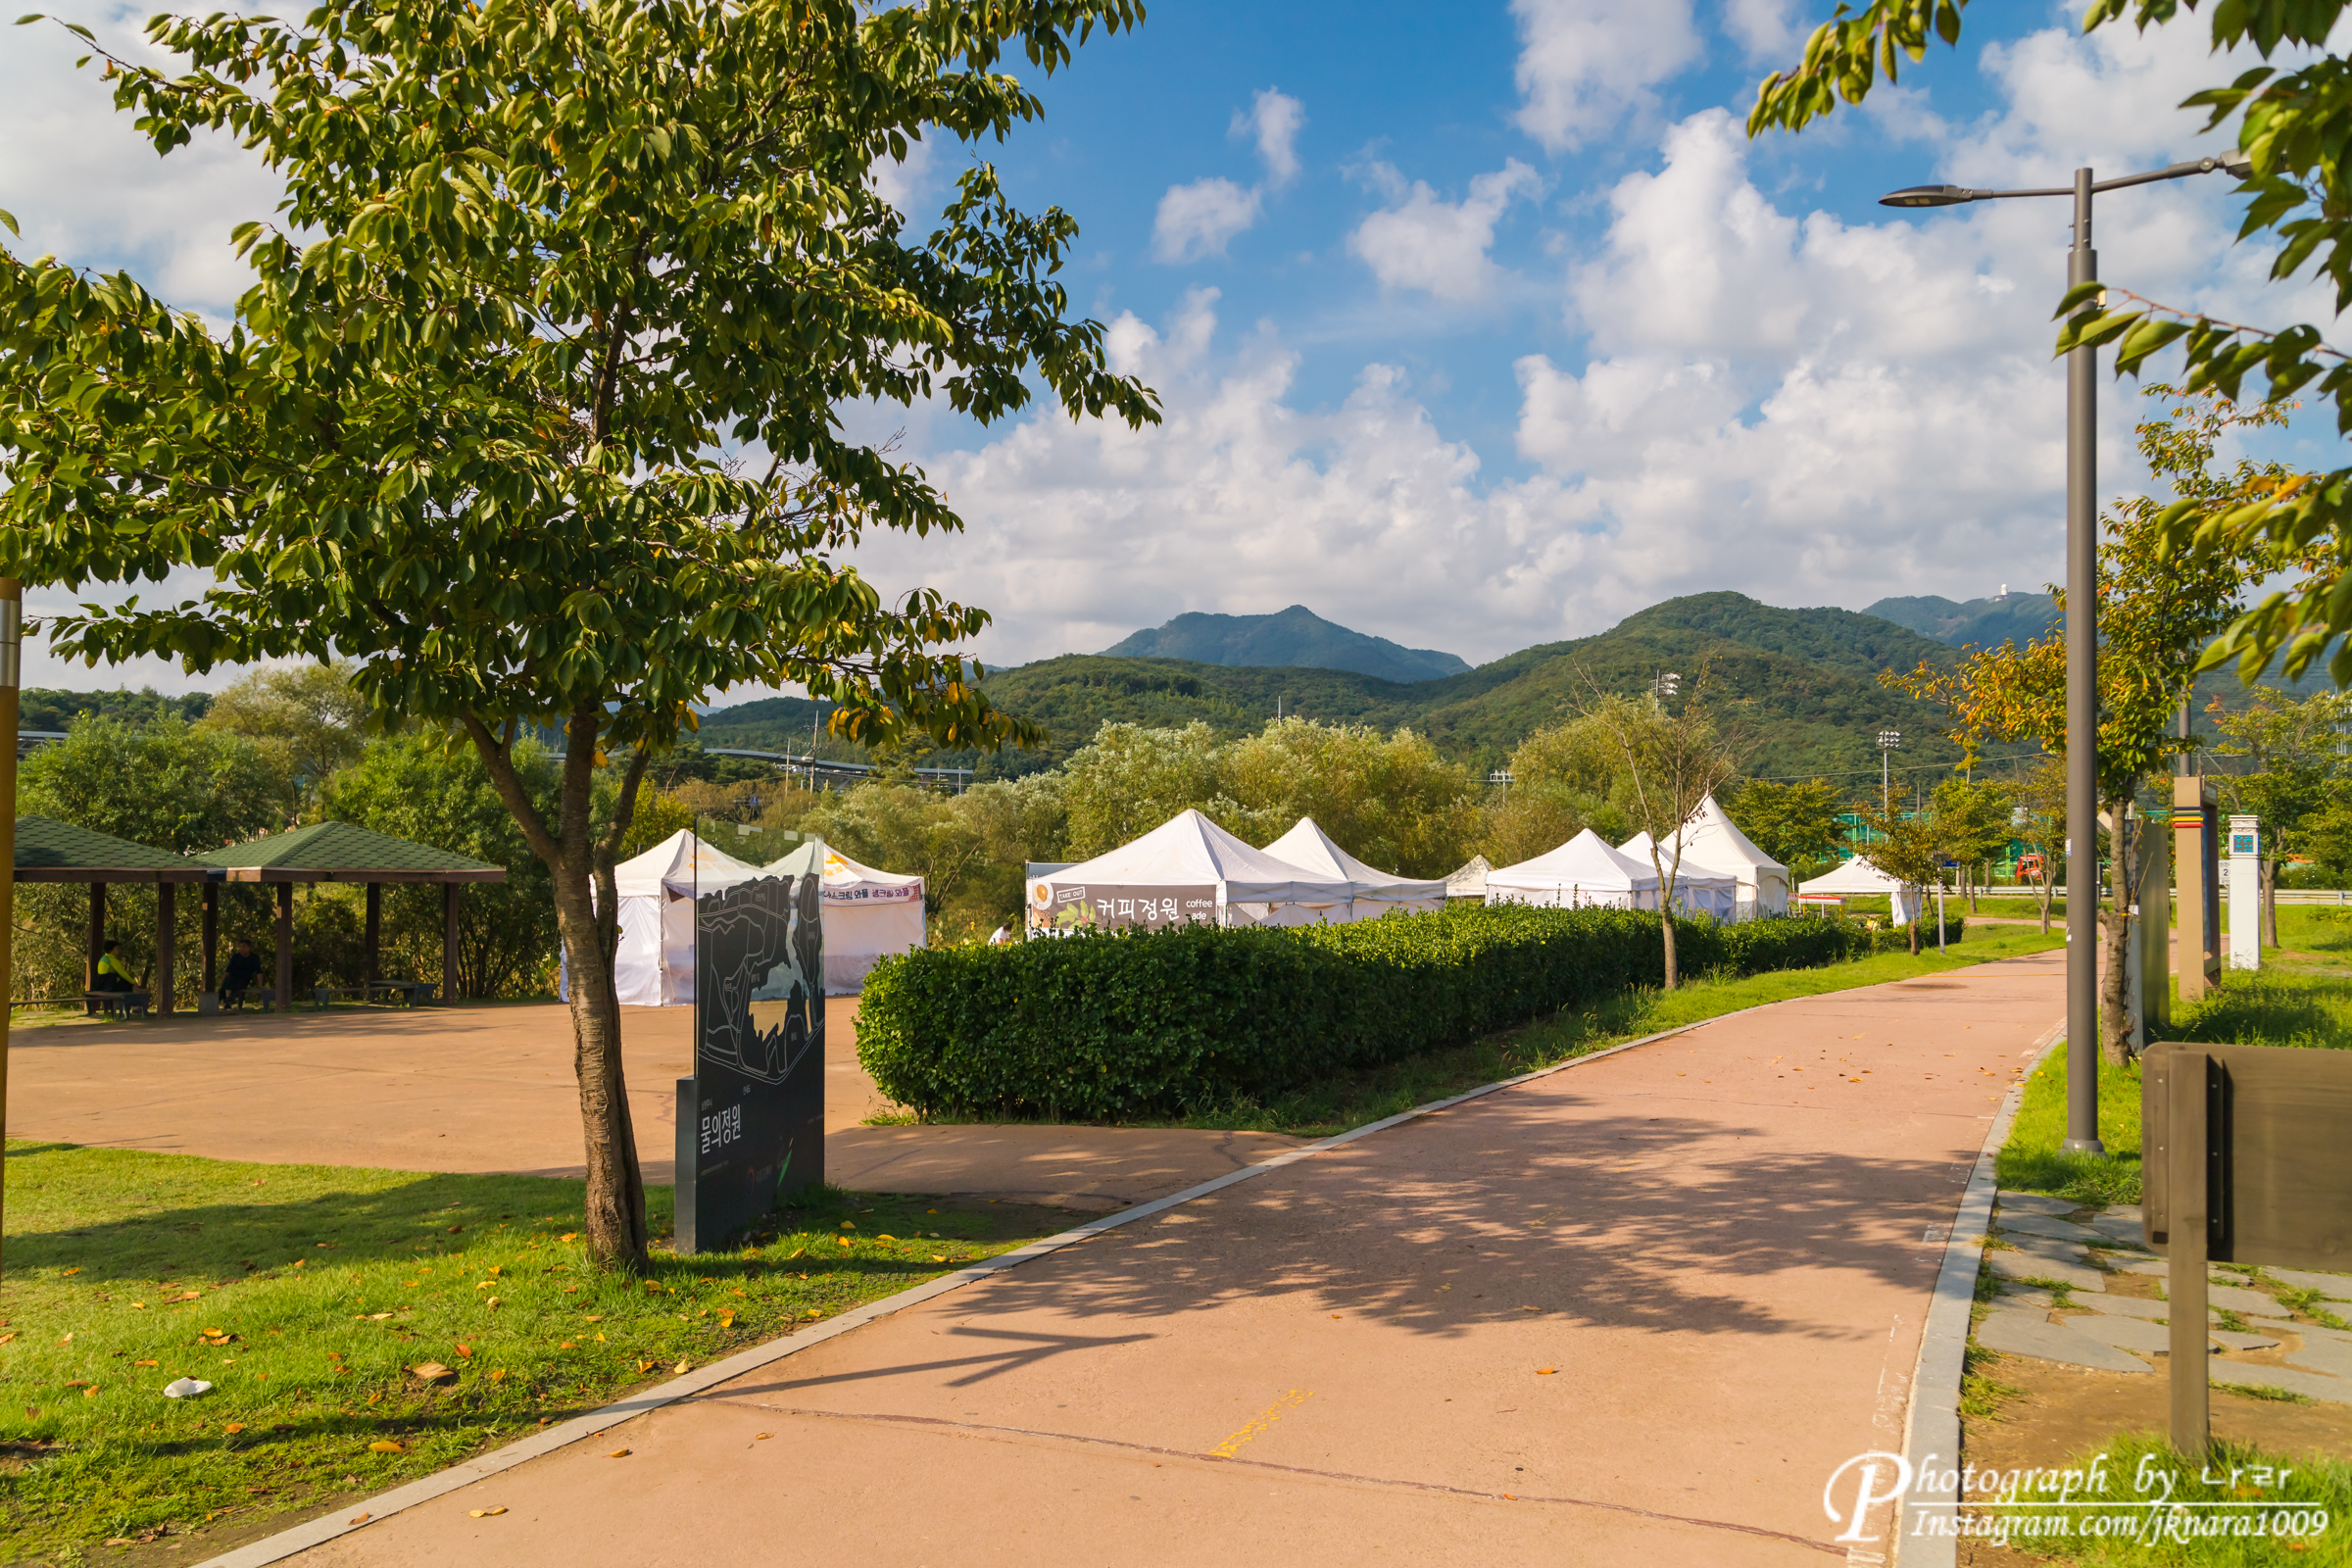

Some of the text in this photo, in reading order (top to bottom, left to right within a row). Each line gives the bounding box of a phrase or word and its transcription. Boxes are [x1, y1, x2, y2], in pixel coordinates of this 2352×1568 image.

[854, 888, 869, 899] 와플
[894, 887, 909, 898] 와플
[1072, 889, 1083, 898] OUT
[1097, 897, 1180, 921] 커피정원
[1186, 899, 1213, 908] coffee
[1192, 910, 1207, 920] ade
[701, 1103, 741, 1154] 물의정원
